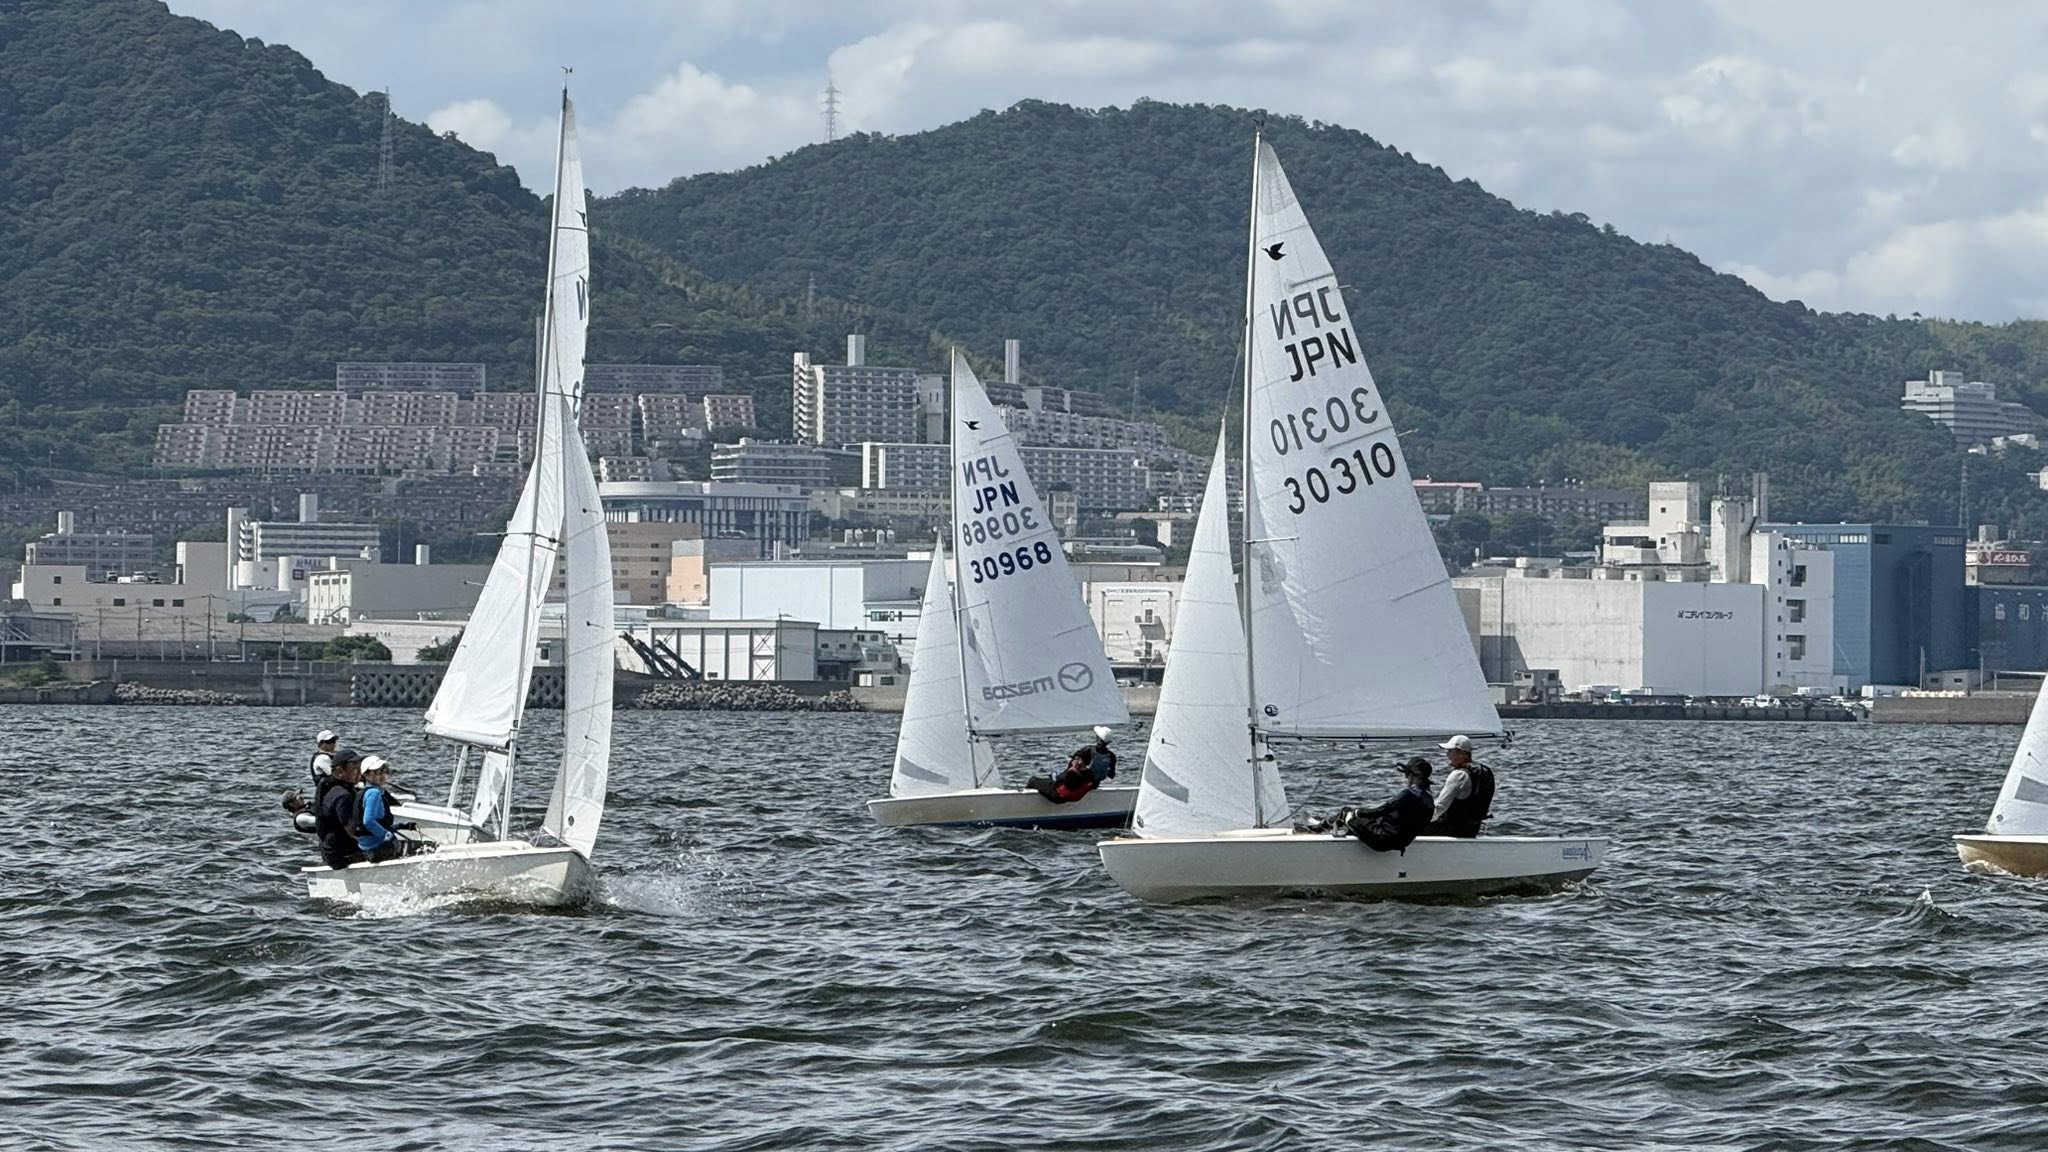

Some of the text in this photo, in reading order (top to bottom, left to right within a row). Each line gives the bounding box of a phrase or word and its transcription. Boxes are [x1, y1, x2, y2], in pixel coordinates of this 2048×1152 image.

[1284, 328, 1356, 382] JPN
[973, 480, 1020, 514] JPN
[1284, 442, 1395, 514] 30310
[971, 541, 1052, 583] 30968
